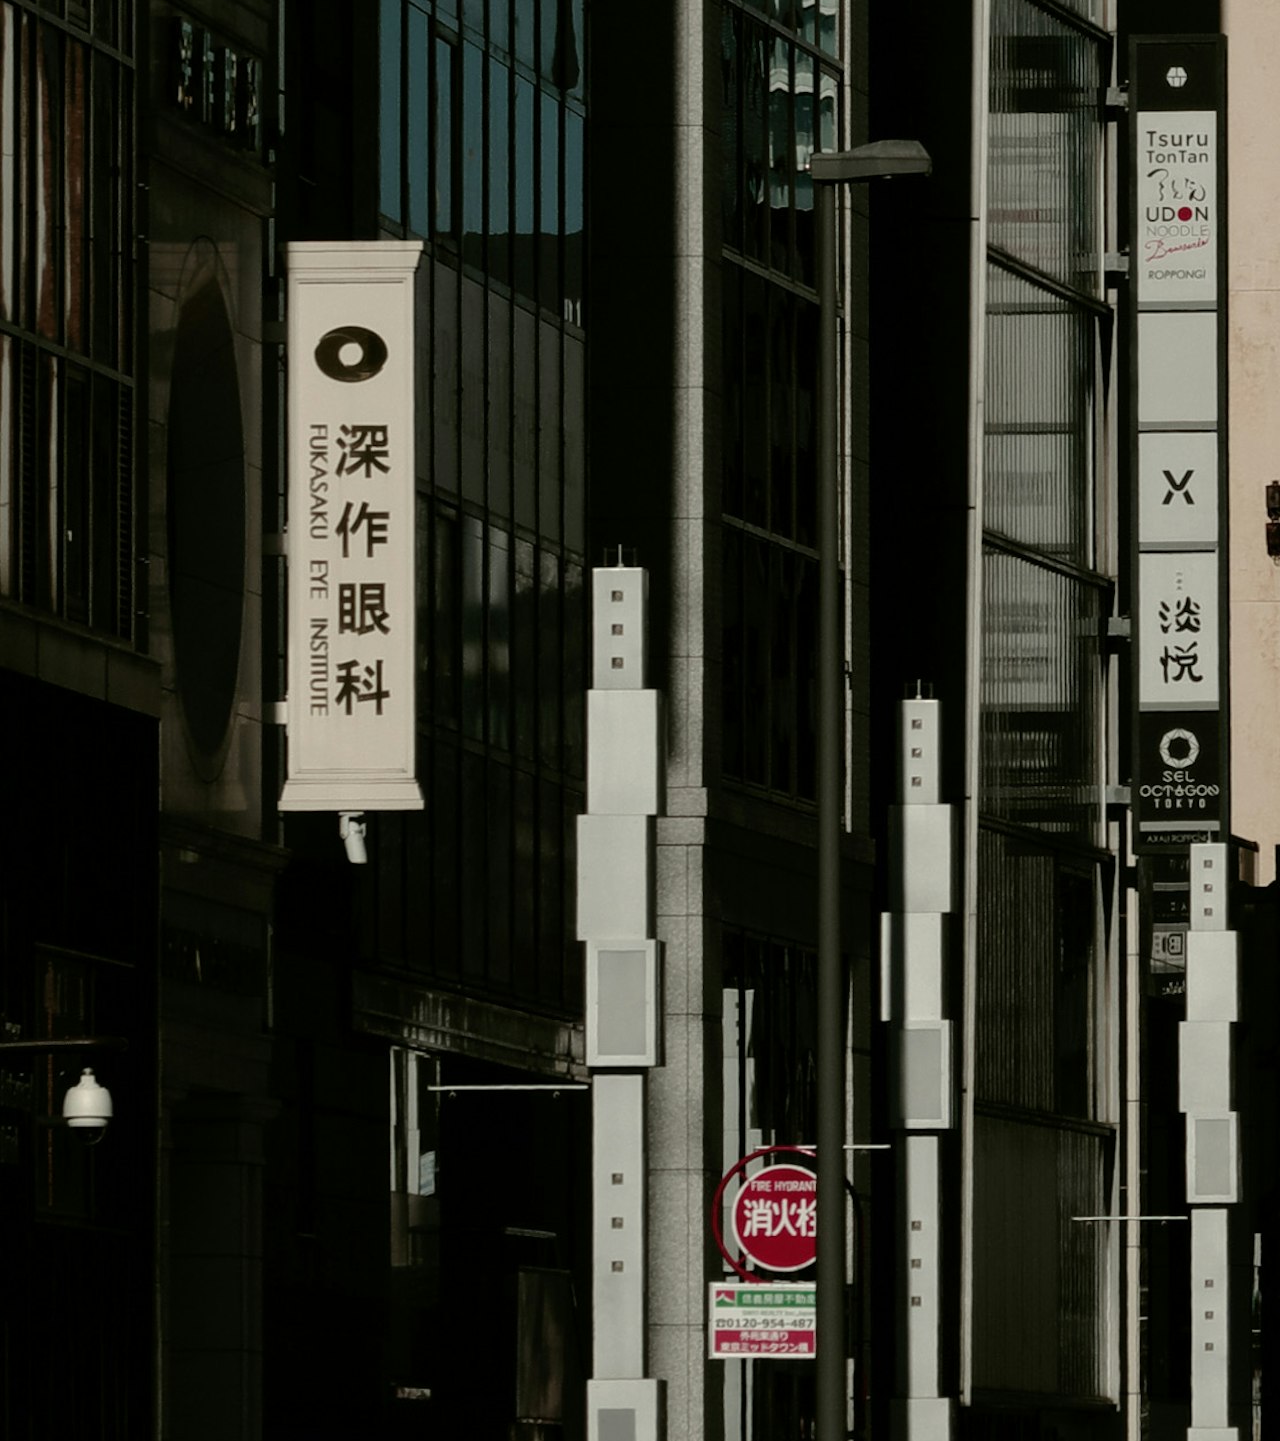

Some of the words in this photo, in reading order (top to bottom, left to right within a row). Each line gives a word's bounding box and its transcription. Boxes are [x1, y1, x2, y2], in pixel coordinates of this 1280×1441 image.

[1146, 130, 1208, 147] Tsuru
[1146, 150, 1209, 163] TonTan
[1146, 207, 1208, 221] UDON
[1146, 225, 1209, 237] NOODLE
[1148, 270, 1206, 280] ROPPONGI
[309, 424, 328, 540] FUKASAKU
[335, 423, 391, 717] 深作眼科
[309, 560, 328, 599] EYE
[309, 618, 328, 717] INSTITUTE
[1162, 770, 1196, 782] SEL
[1139, 784, 1220, 797] OCTAGON
[1153, 798, 1206, 809] TOKYO
[751, 1180, 772, 1193] FIRE
[743, 1198, 817, 1238] 消火栓
